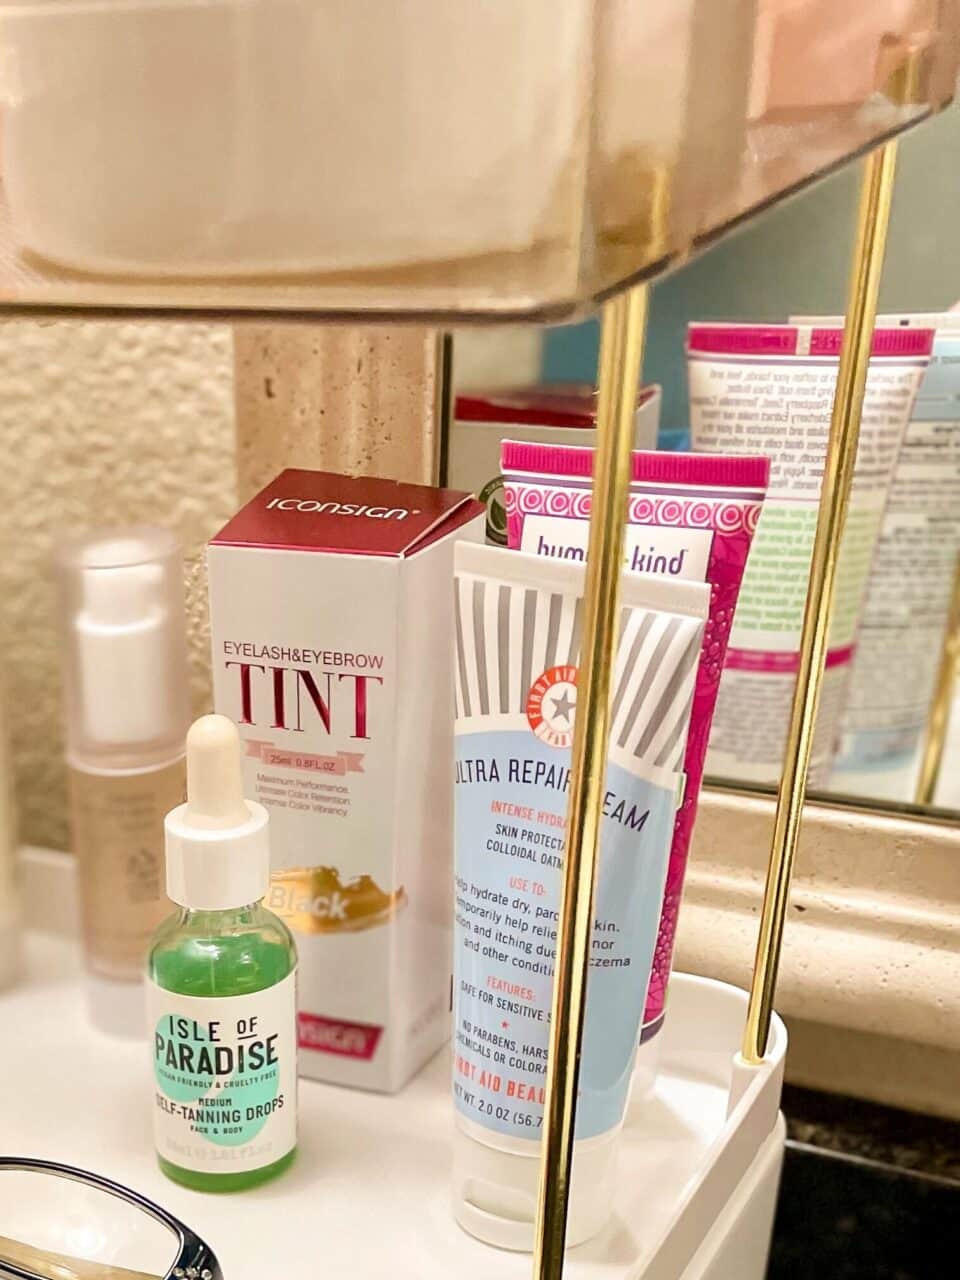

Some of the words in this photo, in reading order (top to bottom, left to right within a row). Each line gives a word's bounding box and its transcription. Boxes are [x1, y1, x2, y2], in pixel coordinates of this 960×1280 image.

[223, 641, 383, 669] EYELASH&EYEBROW
[225, 661, 383, 740] TINT
[491, 800, 534, 821] INTENSE
[495, 823, 519, 838] SKIN
[486, 839, 537, 862] COLLOIDAL
[509, 876, 528, 891] USE
[269, 885, 350, 920] Black
[470, 884, 508, 906] hydrate
[505, 914, 528, 933] help
[473, 924, 491, 938] and
[495, 931, 532, 954] itching
[483, 946, 509, 962] other
[461, 980, 476, 997] SAFE
[478, 990, 493, 1007] FOR
[496, 999, 543, 1022] SENSITIVE
[169, 1015, 221, 1042] ISLE
[237, 1016, 258, 1034] OF
[463, 1020, 471, 1033] NO
[473, 1026, 519, 1053] PARABENS,
[155, 1032, 279, 1075] PARADISE
[494, 1052, 505, 1065] OR
[177, 1075, 212, 1089] FRIENDLY
[224, 1077, 258, 1089] CRUELTY
[260, 1069, 276, 1083] FREE
[480, 1070, 501, 1092] AID
[156, 1093, 240, 1124] SELF-TANNING
[246, 1095, 285, 1121] DROPS
[198, 1097, 232, 1107] MEDIUM
[478, 1099, 493, 1115] 2.0
[496, 1106, 510, 1121] OZ
[190, 1125, 208, 1134] FACE
[223, 1126, 243, 1134] BODY
